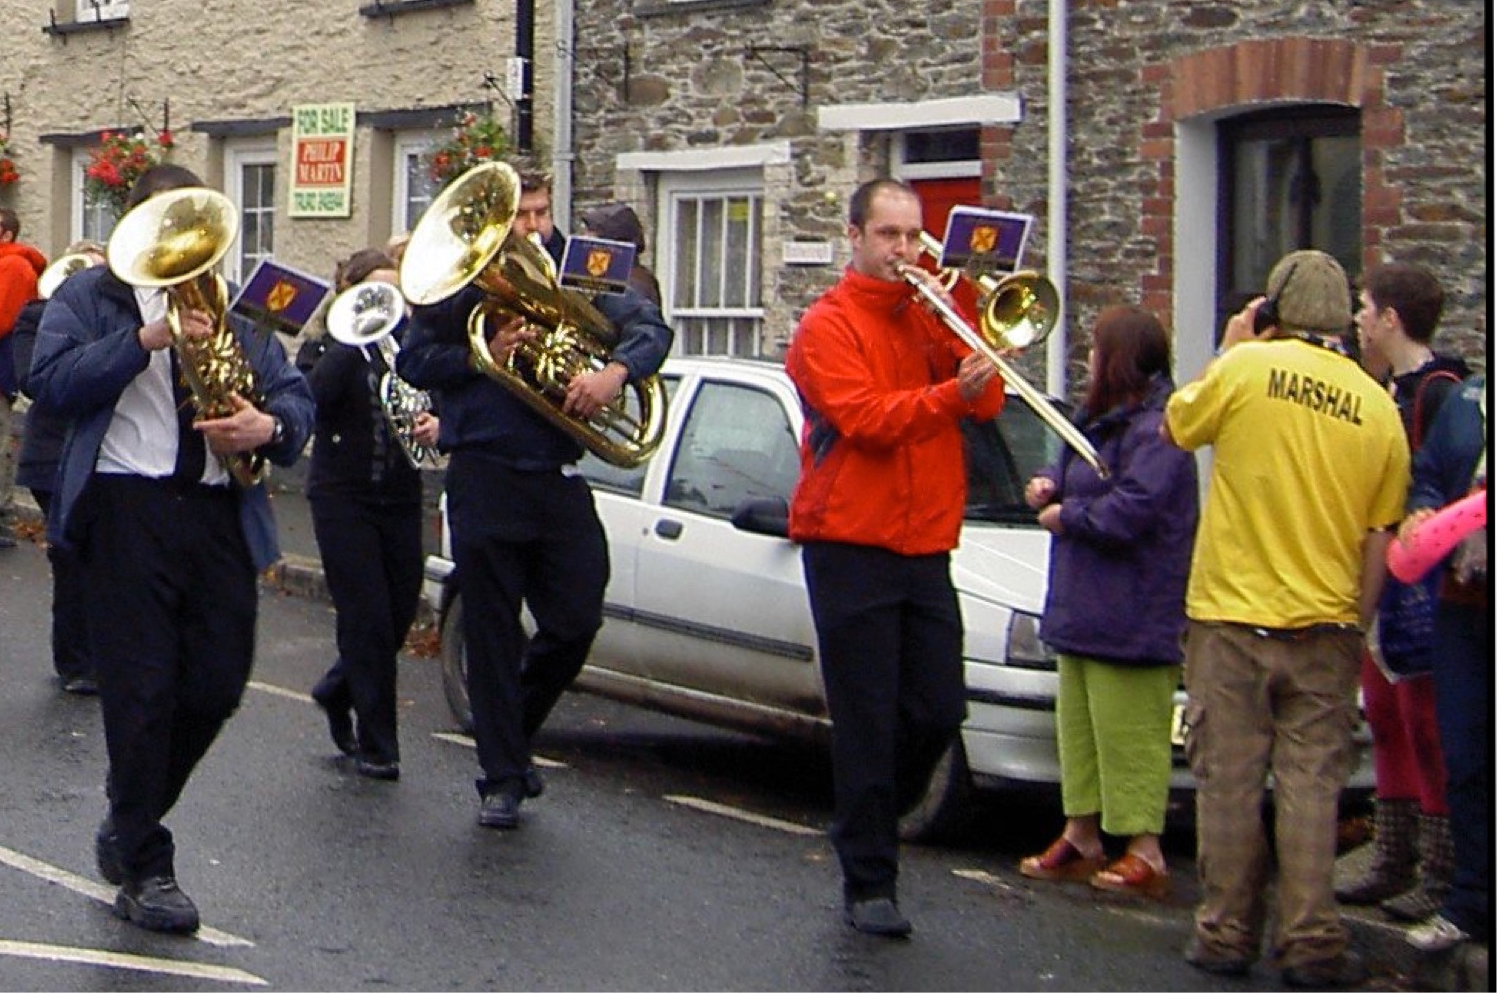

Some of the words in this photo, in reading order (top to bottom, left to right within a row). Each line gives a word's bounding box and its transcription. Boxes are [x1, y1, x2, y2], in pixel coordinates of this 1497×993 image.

[298, 109, 318, 134] FOR
[321, 108, 348, 133] SALE
[303, 142, 342, 162] PHILIP
[298, 163, 342, 182] MARTIN
[1267, 367, 1362, 426] MARSHAL
